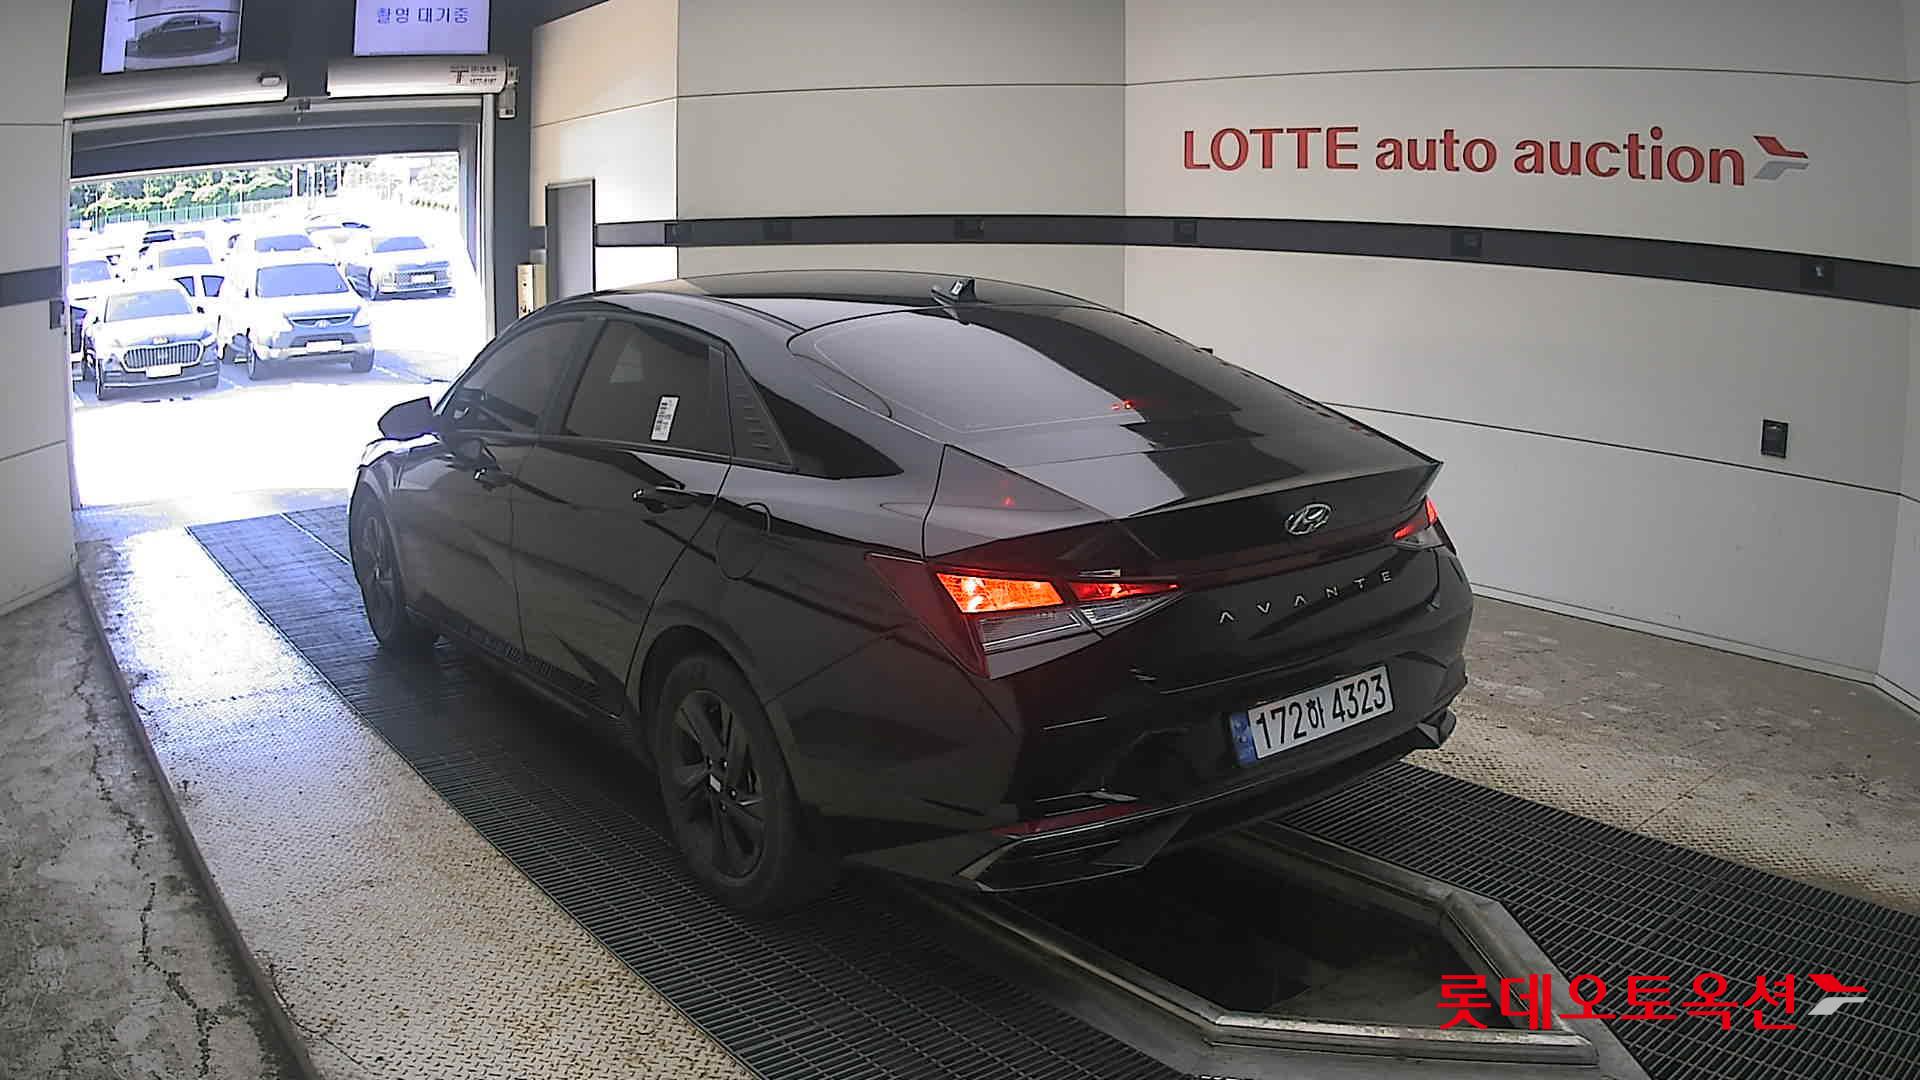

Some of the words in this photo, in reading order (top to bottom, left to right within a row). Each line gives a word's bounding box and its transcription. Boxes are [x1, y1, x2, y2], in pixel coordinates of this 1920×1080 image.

[417, 7, 469, 24] 대기중
[1184, 126, 1359, 171] LOTTE
[1376, 129, 1497, 172] auto
[1515, 126, 1744, 186] auction
[1219, 570, 1392, 623] AVANTE
[1255, 697, 1326, 749] 172하
[1331, 673, 1387, 723] 4323
